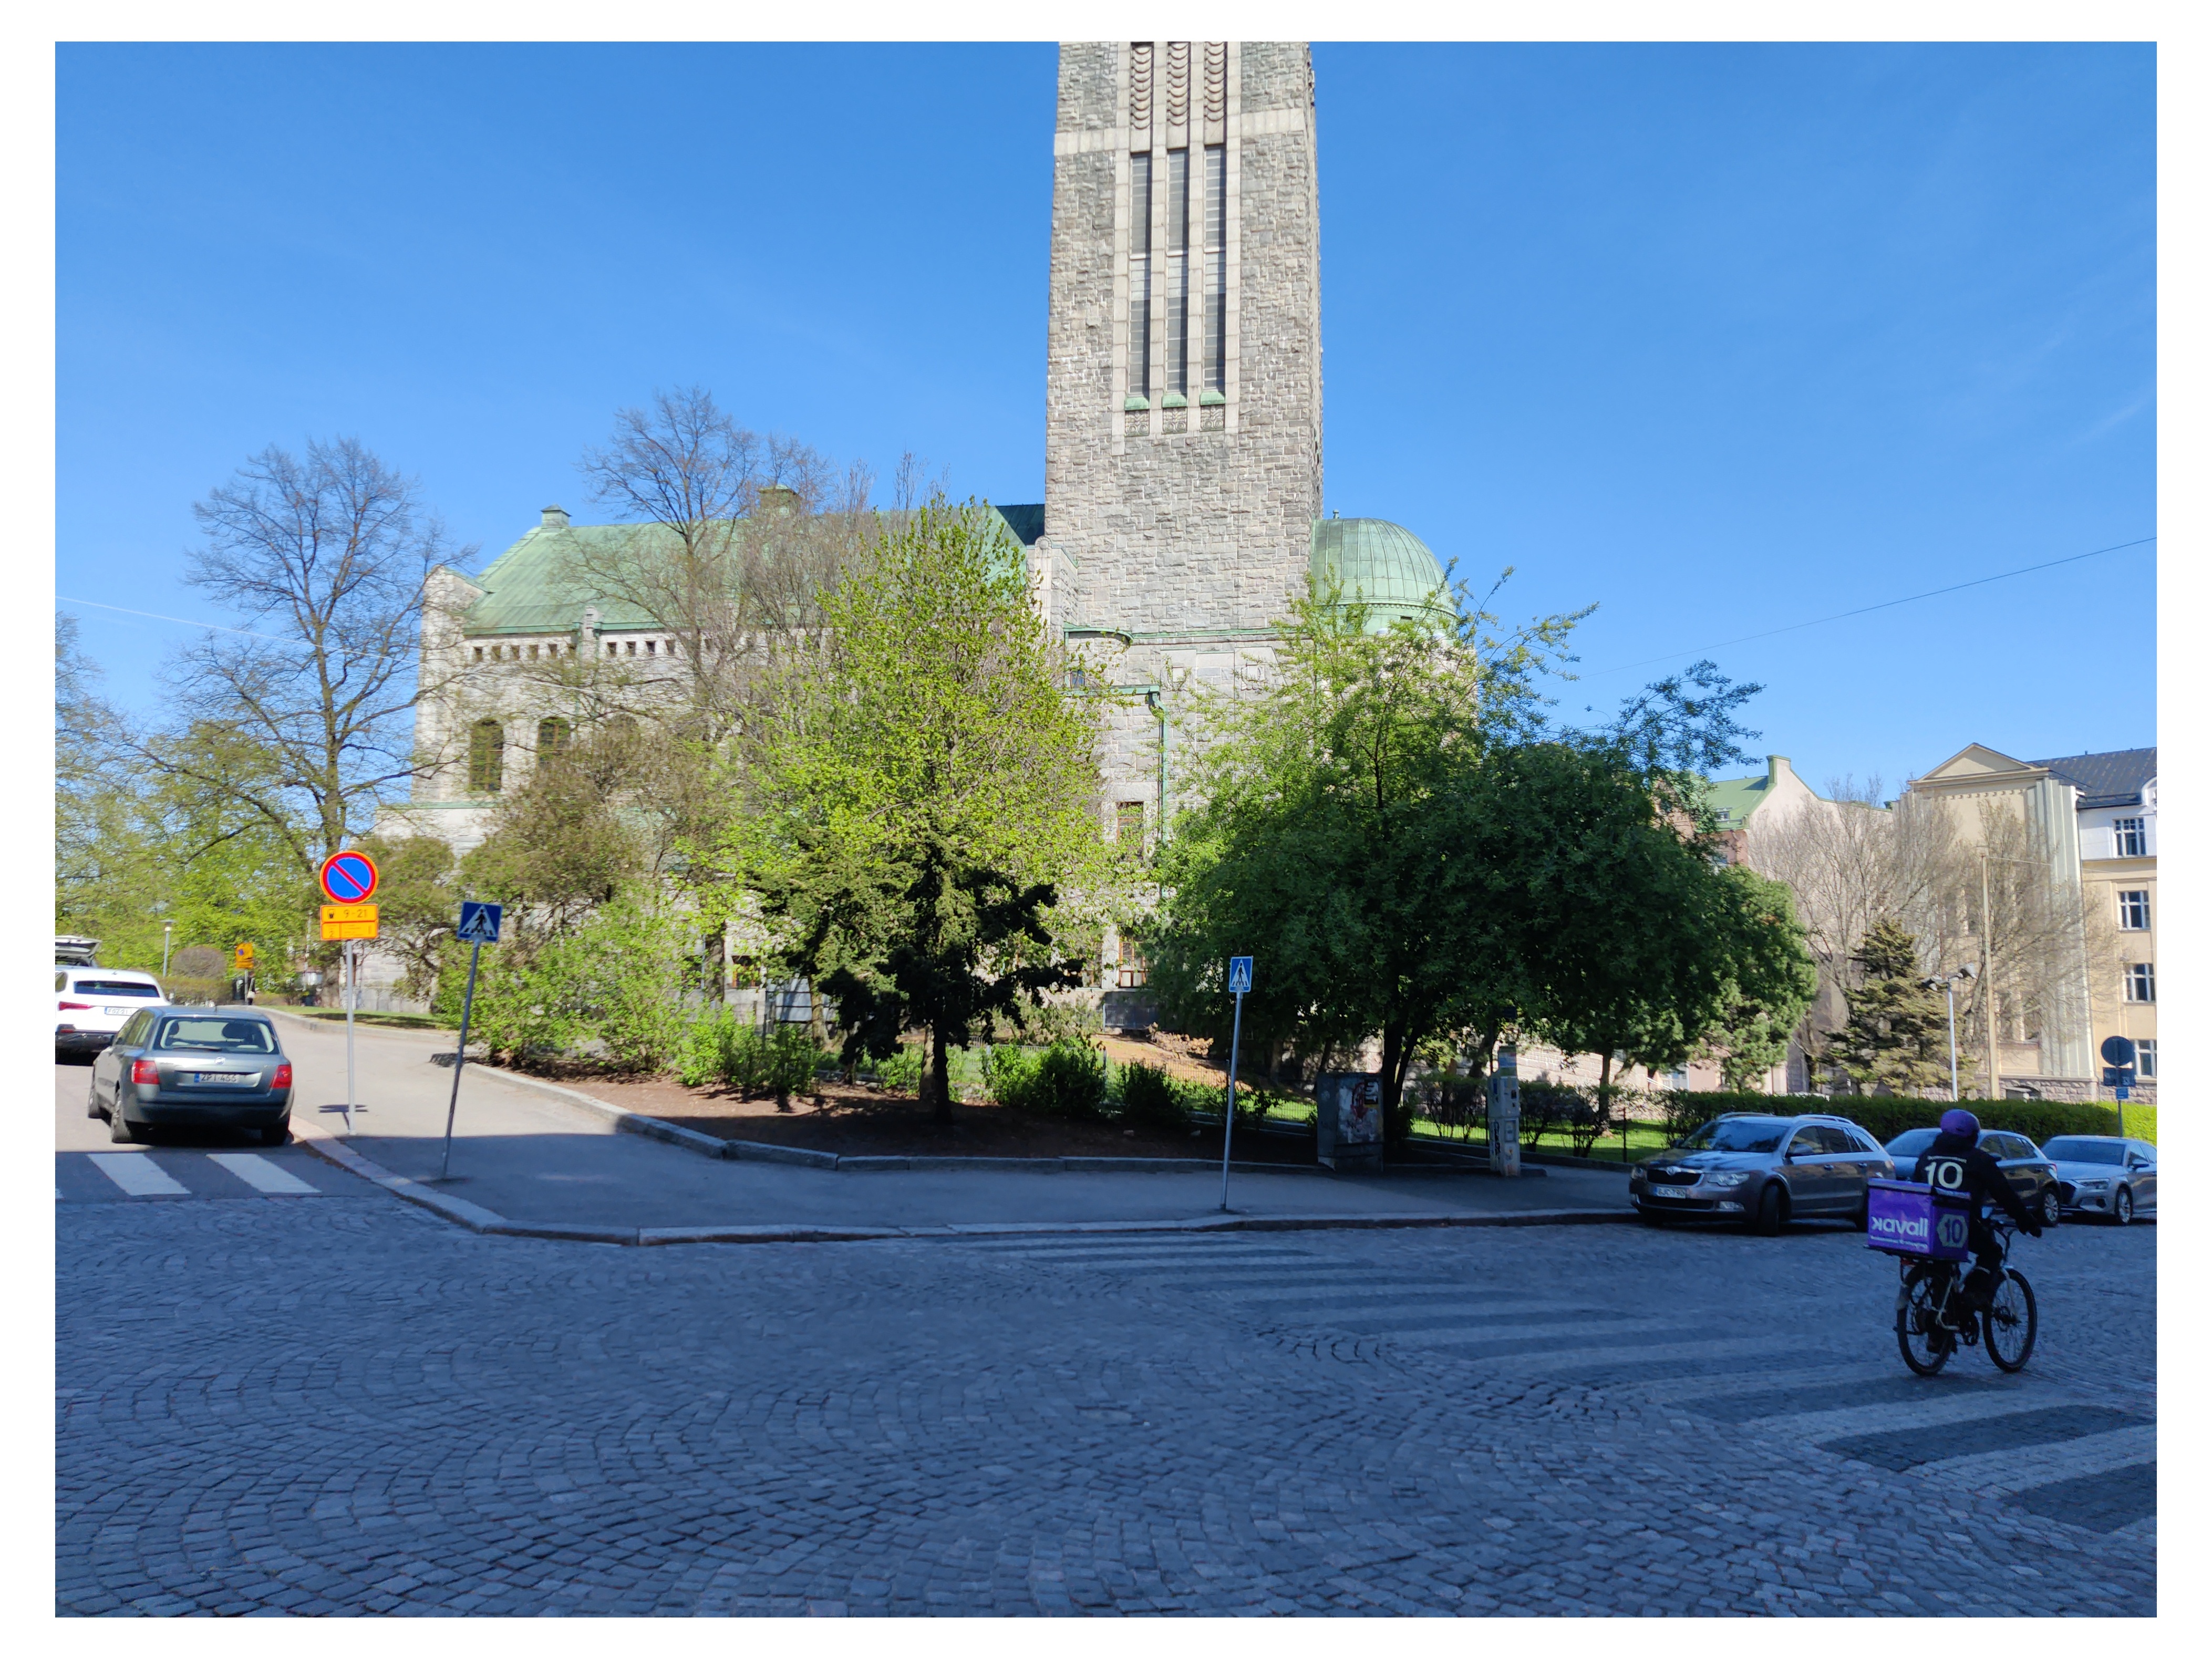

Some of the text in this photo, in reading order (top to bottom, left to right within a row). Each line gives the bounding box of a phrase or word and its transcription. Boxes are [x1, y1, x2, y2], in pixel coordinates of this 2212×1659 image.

[1924, 1162, 1963, 1189] 10
[1871, 1216, 1928, 1237] kavall
[1945, 1219, 1963, 1243] 10
